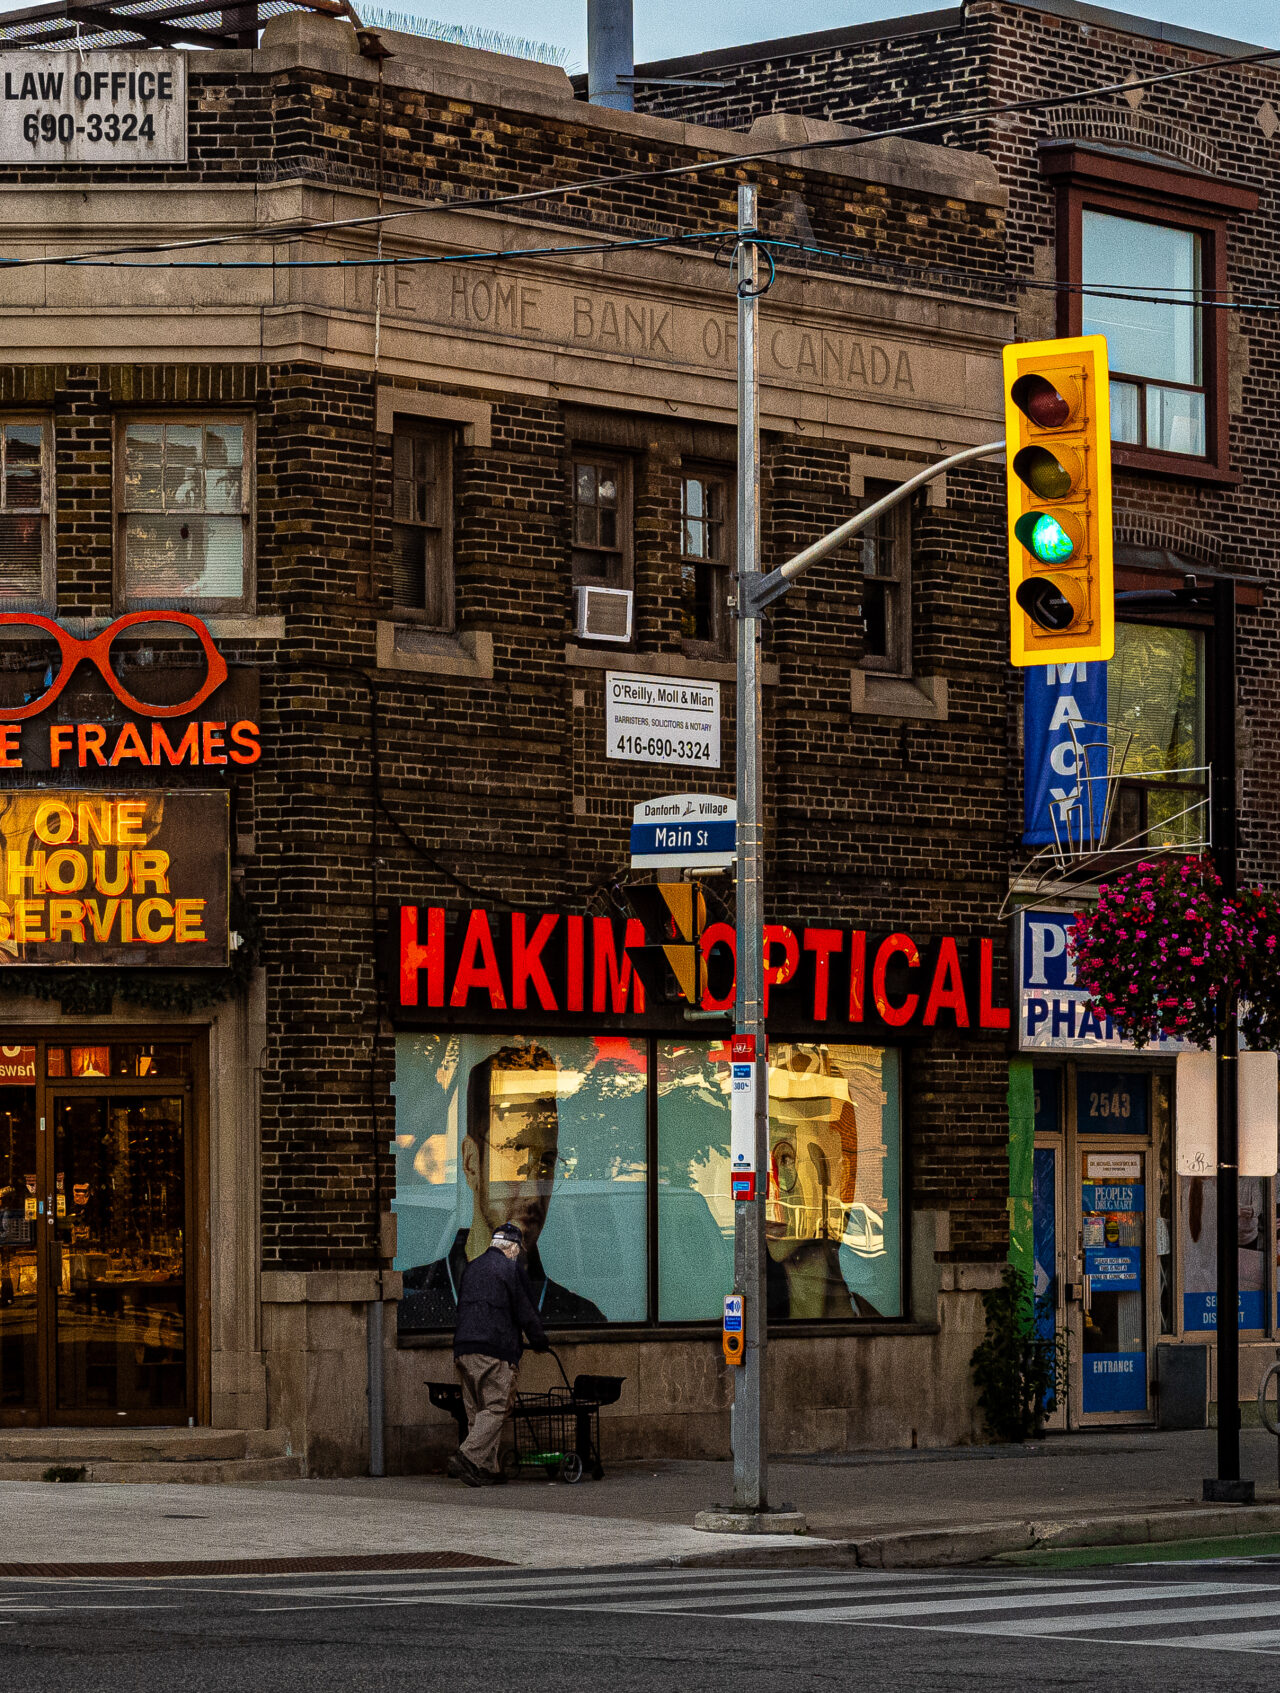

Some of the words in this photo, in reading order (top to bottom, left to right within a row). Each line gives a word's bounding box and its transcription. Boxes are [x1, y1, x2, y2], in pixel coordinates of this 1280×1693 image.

[4, 71, 65, 101] LAW
[73, 71, 173, 101] OFFICE
[22, 113, 156, 142] 690-3324
[449, 274, 542, 332] HOME
[572, 295, 671, 351] BANK
[702, 318, 739, 362] OF
[770, 329, 915, 393] CANADA
[612, 683, 656, 704] O'Reilly,
[658, 688, 679, 704] Moll
[680, 691, 689, 704] &
[690, 692, 714, 707] Mian
[614, 715, 651, 727] BARRISTERS,
[651, 719, 684, 730] SOLICITORS
[684, 722, 689, 730] &
[690, 723, 712, 732] NOTARY
[50, 720, 262, 768] FRAMES
[616, 734, 711, 761] 416-690-3324
[644, 804, 681, 816] Danforth
[698, 803, 728, 816] Village
[33, 802, 148, 846] ONE
[654, 826, 692, 848] Main
[696, 830, 709, 846] St
[7, 849, 171, 896] HOUR
[399, 905, 647, 1014] HAKIM
[698, 922, 1012, 1029] OPTICAL
[1089, 1092, 1131, 1118] 2543
[1095, 1187, 1133, 1200] PEOPLES
[1095, 1200, 1114, 1210] DRUG
[1114, 1200, 1132, 1210] MART
[1093, 1360, 1134, 1373] ENTRANCE
